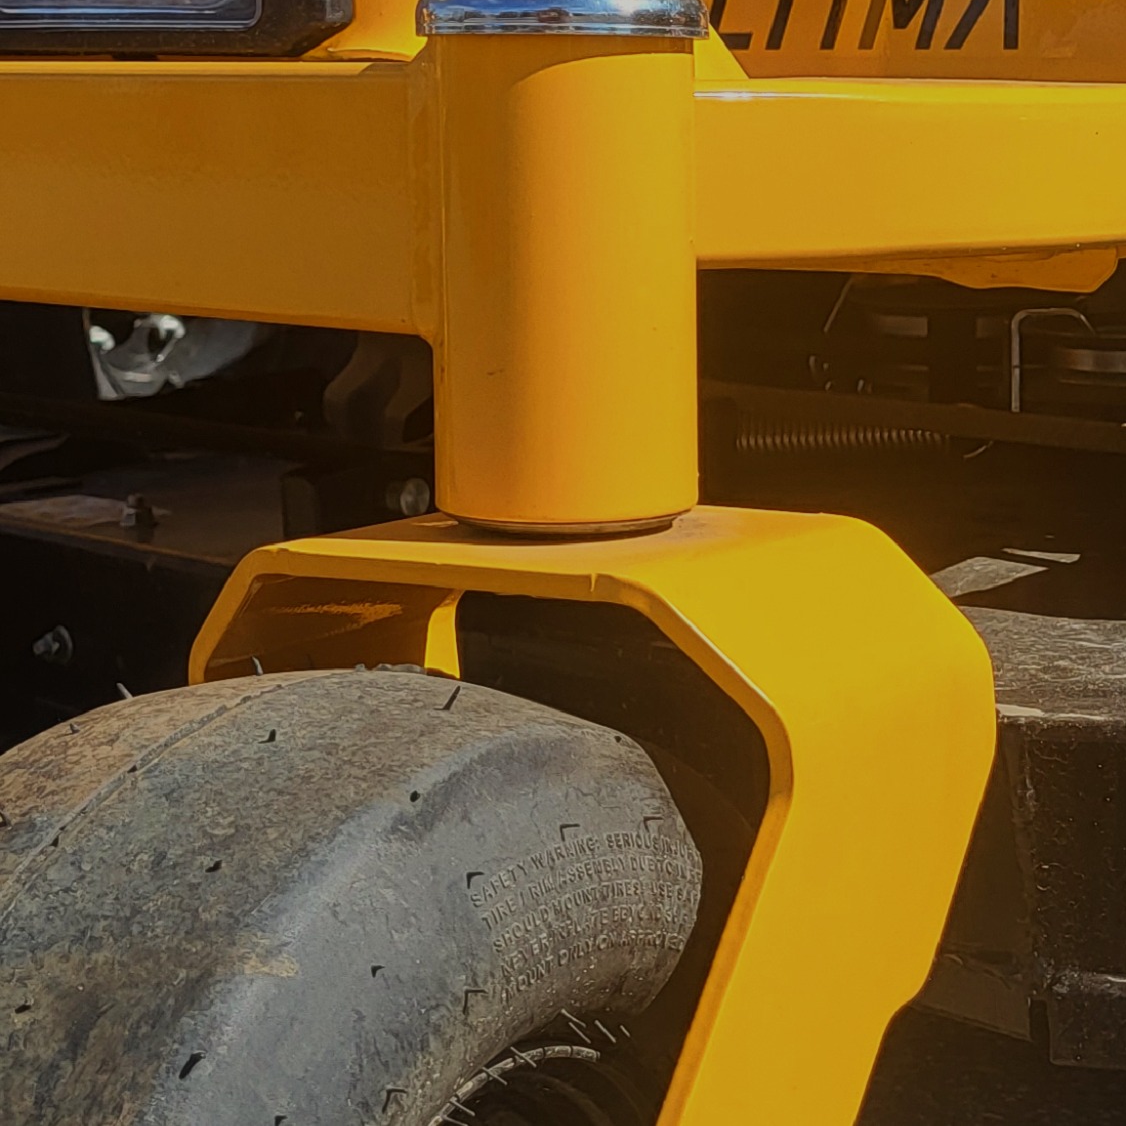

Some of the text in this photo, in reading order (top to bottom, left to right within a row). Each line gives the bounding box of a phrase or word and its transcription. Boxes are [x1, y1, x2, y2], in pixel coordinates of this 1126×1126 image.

[470, 860, 528, 909] SAFETY
[605, 832, 659, 852] SERIOUS
[481, 896, 518, 932] TIRE
[493, 904, 551, 954] SHOULD
